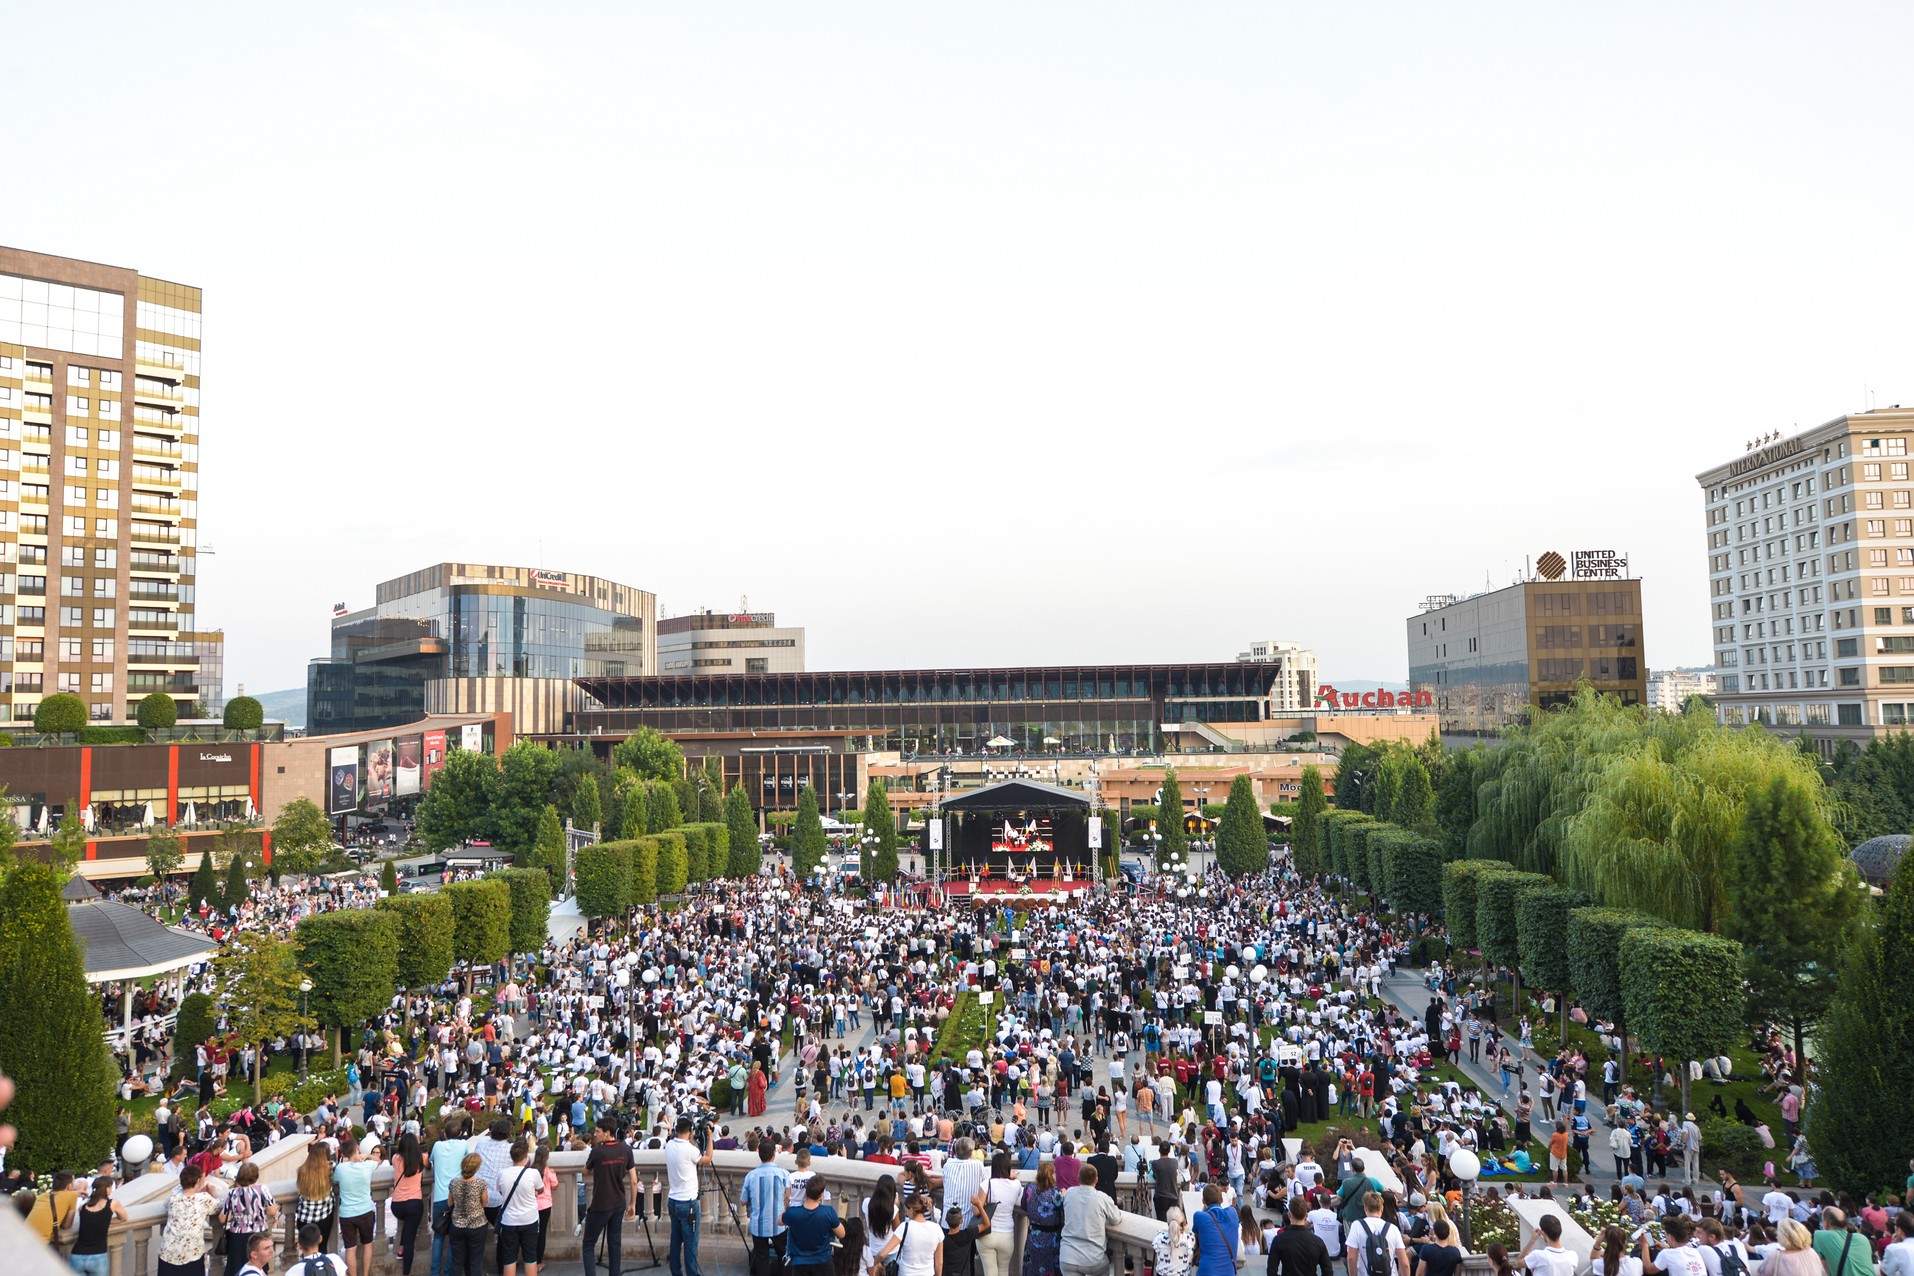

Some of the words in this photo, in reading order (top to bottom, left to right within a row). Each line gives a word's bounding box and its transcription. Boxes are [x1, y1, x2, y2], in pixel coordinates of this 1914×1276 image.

[1728, 438, 1802, 477] INTERNATIONAL
[1575, 550, 1616, 559] UNITED
[1576, 558, 1627, 568] BUSINESS
[1576, 568, 1619, 577] CENTER
[1314, 685, 1432, 708] Auchan
